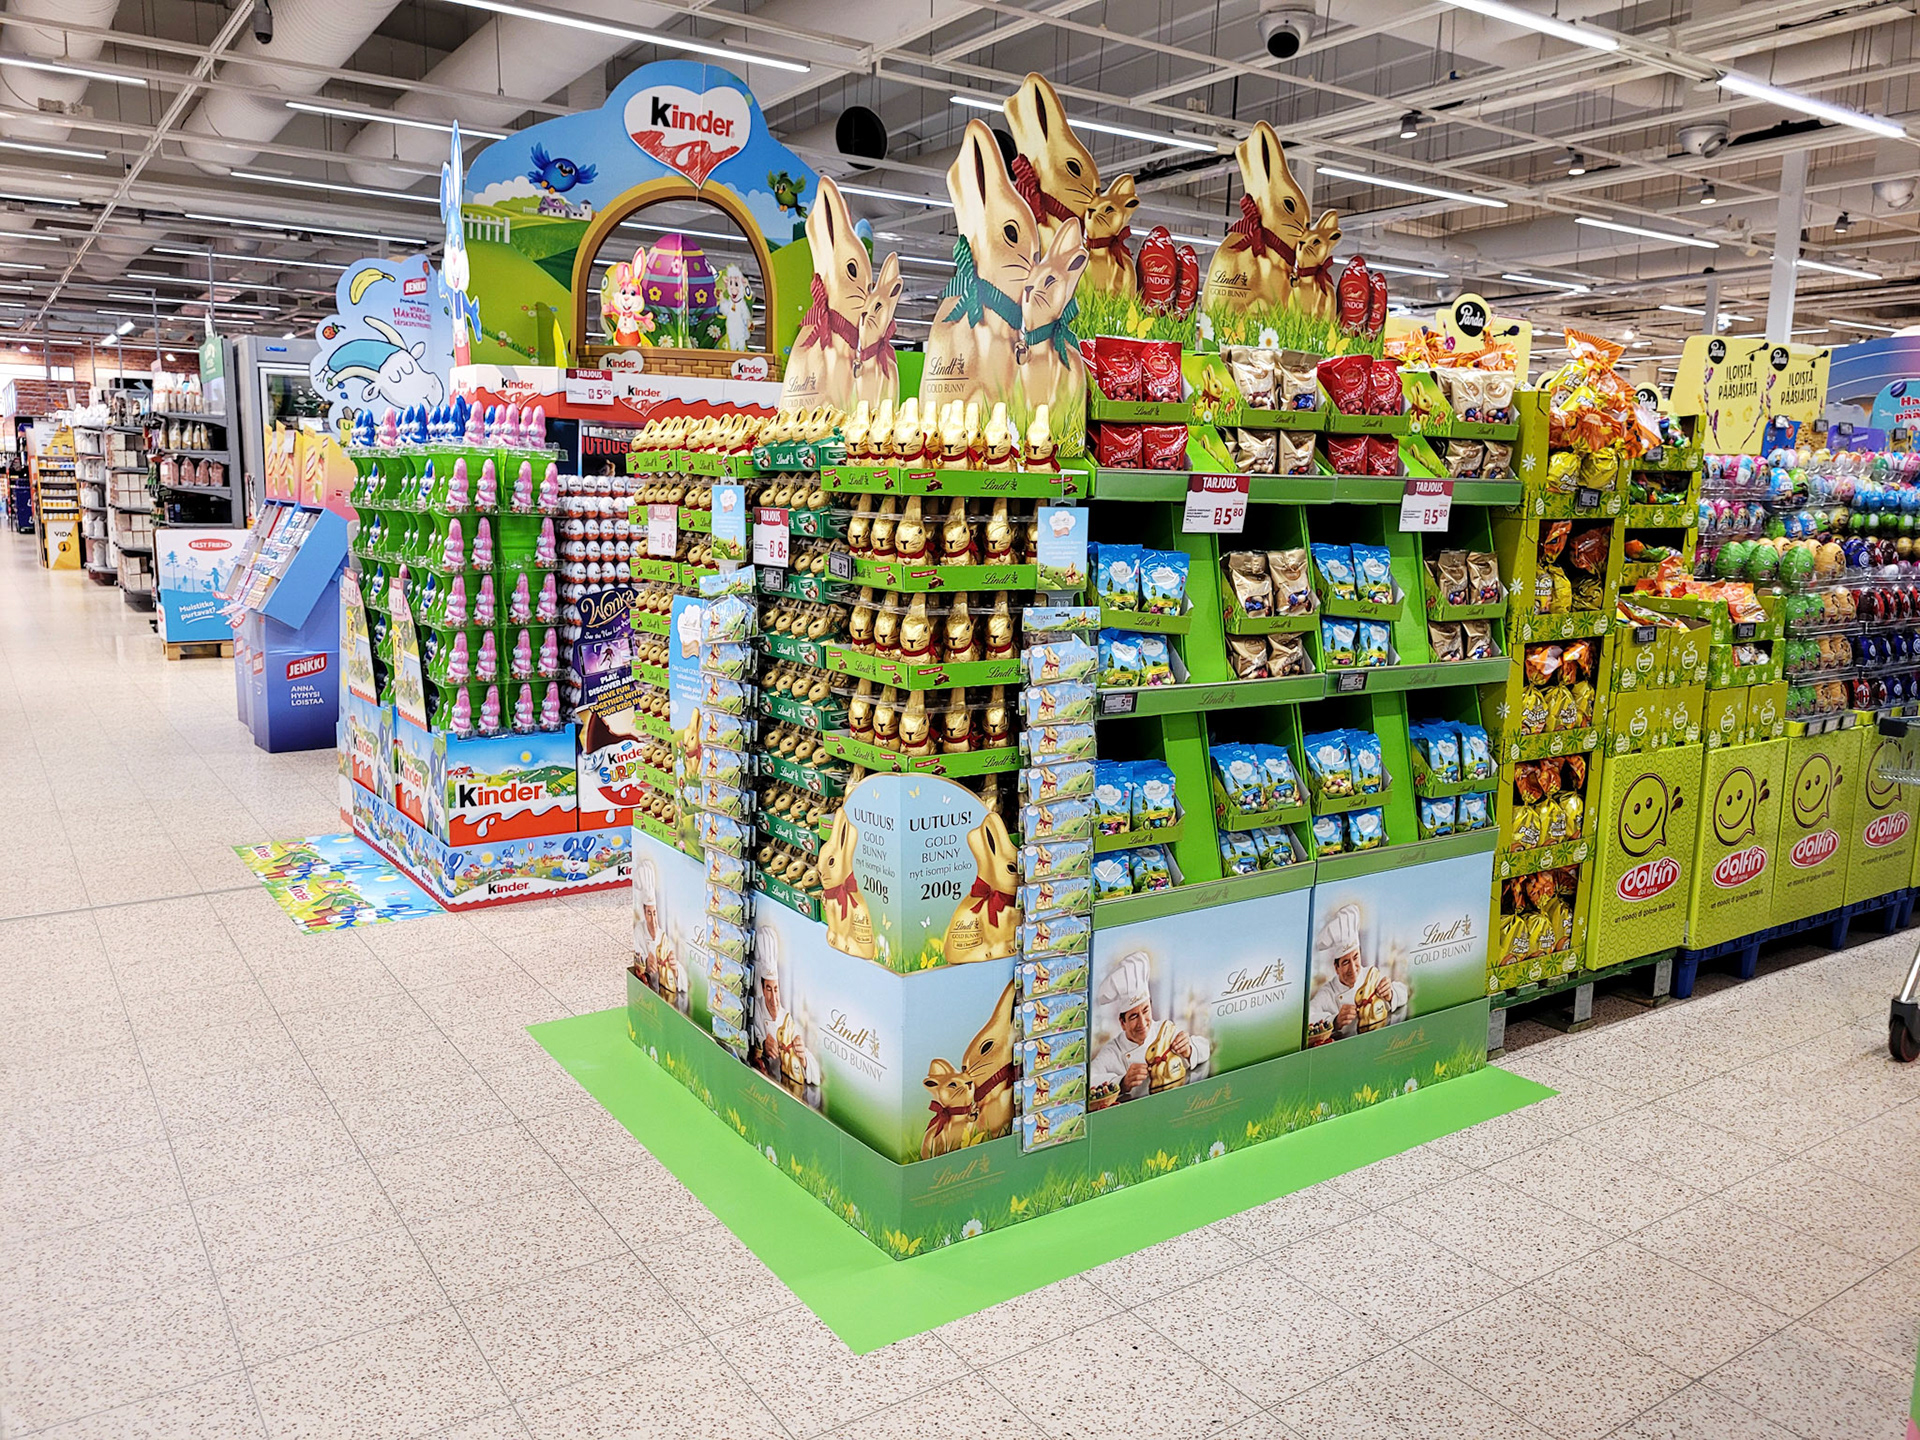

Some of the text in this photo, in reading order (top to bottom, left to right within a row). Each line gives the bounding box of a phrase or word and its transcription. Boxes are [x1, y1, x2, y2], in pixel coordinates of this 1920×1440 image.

[651, 96, 734, 138] Kinder
[1145, 261, 1166, 273] Lindt
[1143, 276, 1171, 286] LINDOR
[1212, 270, 1240, 286] Lindt
[1209, 288, 1250, 298] GOLD BUNNY
[1459, 305, 1485, 327] Panda
[1710, 341, 1726, 358] Panda
[606, 356, 637, 369] Kinder
[737, 362, 763, 375] Kinder
[928, 356, 957, 376] Lindt
[501, 376, 534, 391] Kinder
[627, 384, 662, 399] Kinder
[786, 377, 809, 393] Lindt
[926, 383, 966, 394] GOLD BUNNY
[1133, 405, 1154, 416] Lindt
[847, 472, 864, 486] Lindt
[980, 477, 1011, 491] Lindt
[1203, 476, 1237, 489] TARJOUS
[1416, 481, 1444, 493] TARJOUS
[760, 509, 781, 522] TARJOUS
[206, 541, 231, 549] FRIEND
[980, 572, 1012, 585] Lindt
[179, 600, 214, 613] Muistitko
[180, 606, 216, 621] purtavat?
[580, 590, 636, 625] Wonka
[1134, 616, 1155, 627] Lindt
[288, 656, 326, 677] JENKKI
[854, 659, 872, 674] Lindt
[985, 665, 1014, 679] Lindt
[600, 673, 619, 685] PLAY.
[290, 692, 320, 700] HYMYSI
[588, 679, 621, 697] DISCOVER
[597, 685, 631, 702] HAVE FUN
[291, 698, 325, 706] LOISTAA
[589, 695, 625, 714] TOGETHER
[1198, 692, 1230, 706] Lindt
[597, 707, 615, 719] YOUR
[615, 700, 632, 714] KIDS
[352, 730, 374, 759] Kinder
[853, 743, 871, 761] Lindt
[607, 748, 643, 765] Kinde
[982, 753, 1011, 768] Lindt
[400, 758, 422, 788] Kinder
[599, 762, 636, 784] SURP
[458, 783, 543, 809] Kinder
[854, 807, 895, 832] UUTUUS!
[909, 810, 972, 832] UUTUUS!
[1868, 812, 1906, 840] dolfin
[863, 831, 885, 847] GOLD
[924, 834, 957, 849] GOLD
[1128, 834, 1149, 845] Lindt
[1796, 830, 1834, 860] dolfin
[862, 844, 887, 862] BUNNY
[921, 848, 961, 864] BUNNY
[855, 857, 896, 878] nyt isompi koko
[909, 860, 972, 881] nyt isompi koko
[1718, 847, 1763, 880] dolfin
[1624, 858, 1673, 892] dolfin
[487, 881, 530, 895] Kinder
[862, 874, 889, 905] 200g
[920, 879, 962, 902] 200g
[954, 919, 973, 932] Lindt
[1417, 918, 1462, 947] Lindt
[1413, 942, 1473, 966] GOLD BUNNY
[1220, 964, 1274, 997] Lindt
[1216, 988, 1288, 1018] GOLD BUNNY
[826, 1008, 870, 1049] Lindt
[1387, 1028, 1419, 1051] Lindt
[823, 1036, 883, 1083] GOLD BUNNY
[1184, 1088, 1225, 1113] Lindt
[930, 1158, 981, 1190] Lindt
